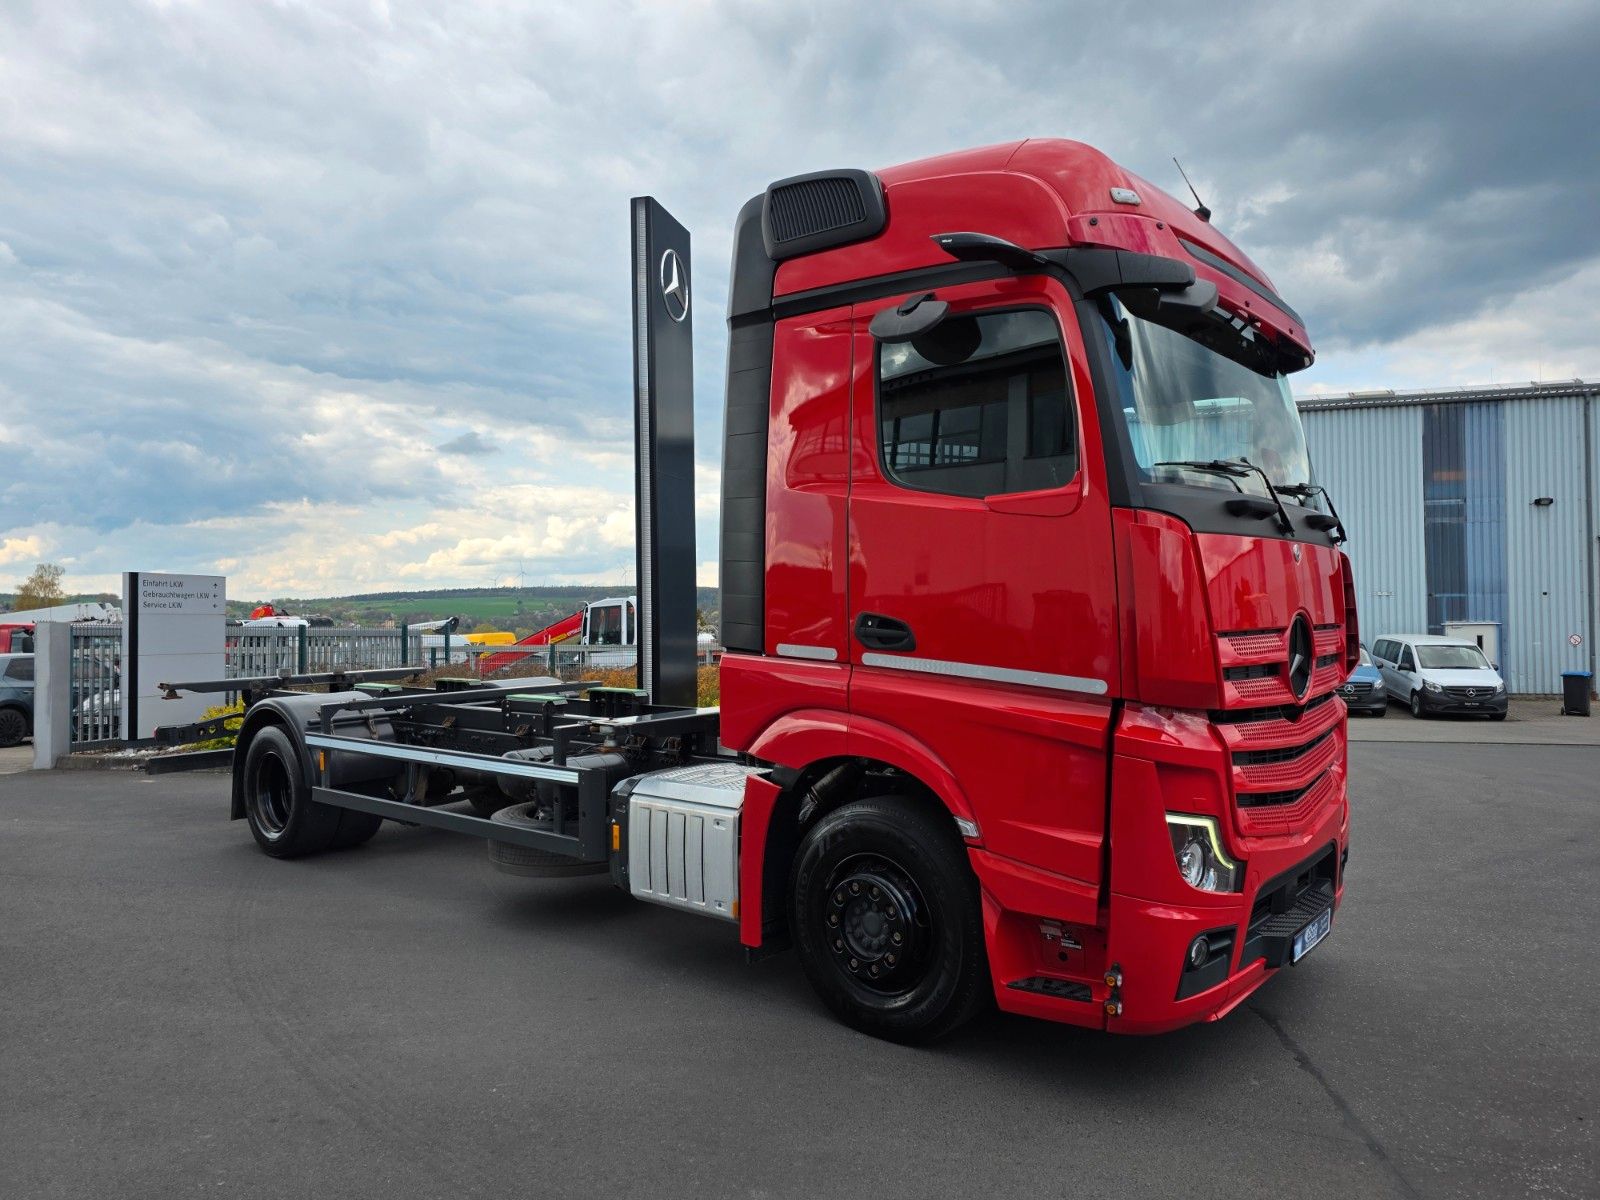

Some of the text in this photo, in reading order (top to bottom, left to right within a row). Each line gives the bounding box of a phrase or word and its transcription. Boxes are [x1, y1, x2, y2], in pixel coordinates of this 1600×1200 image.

[143, 580, 168, 588] Einfahrt
[143, 591, 195, 599] Gebrauchtwagen
[143, 601, 167, 609] Service
